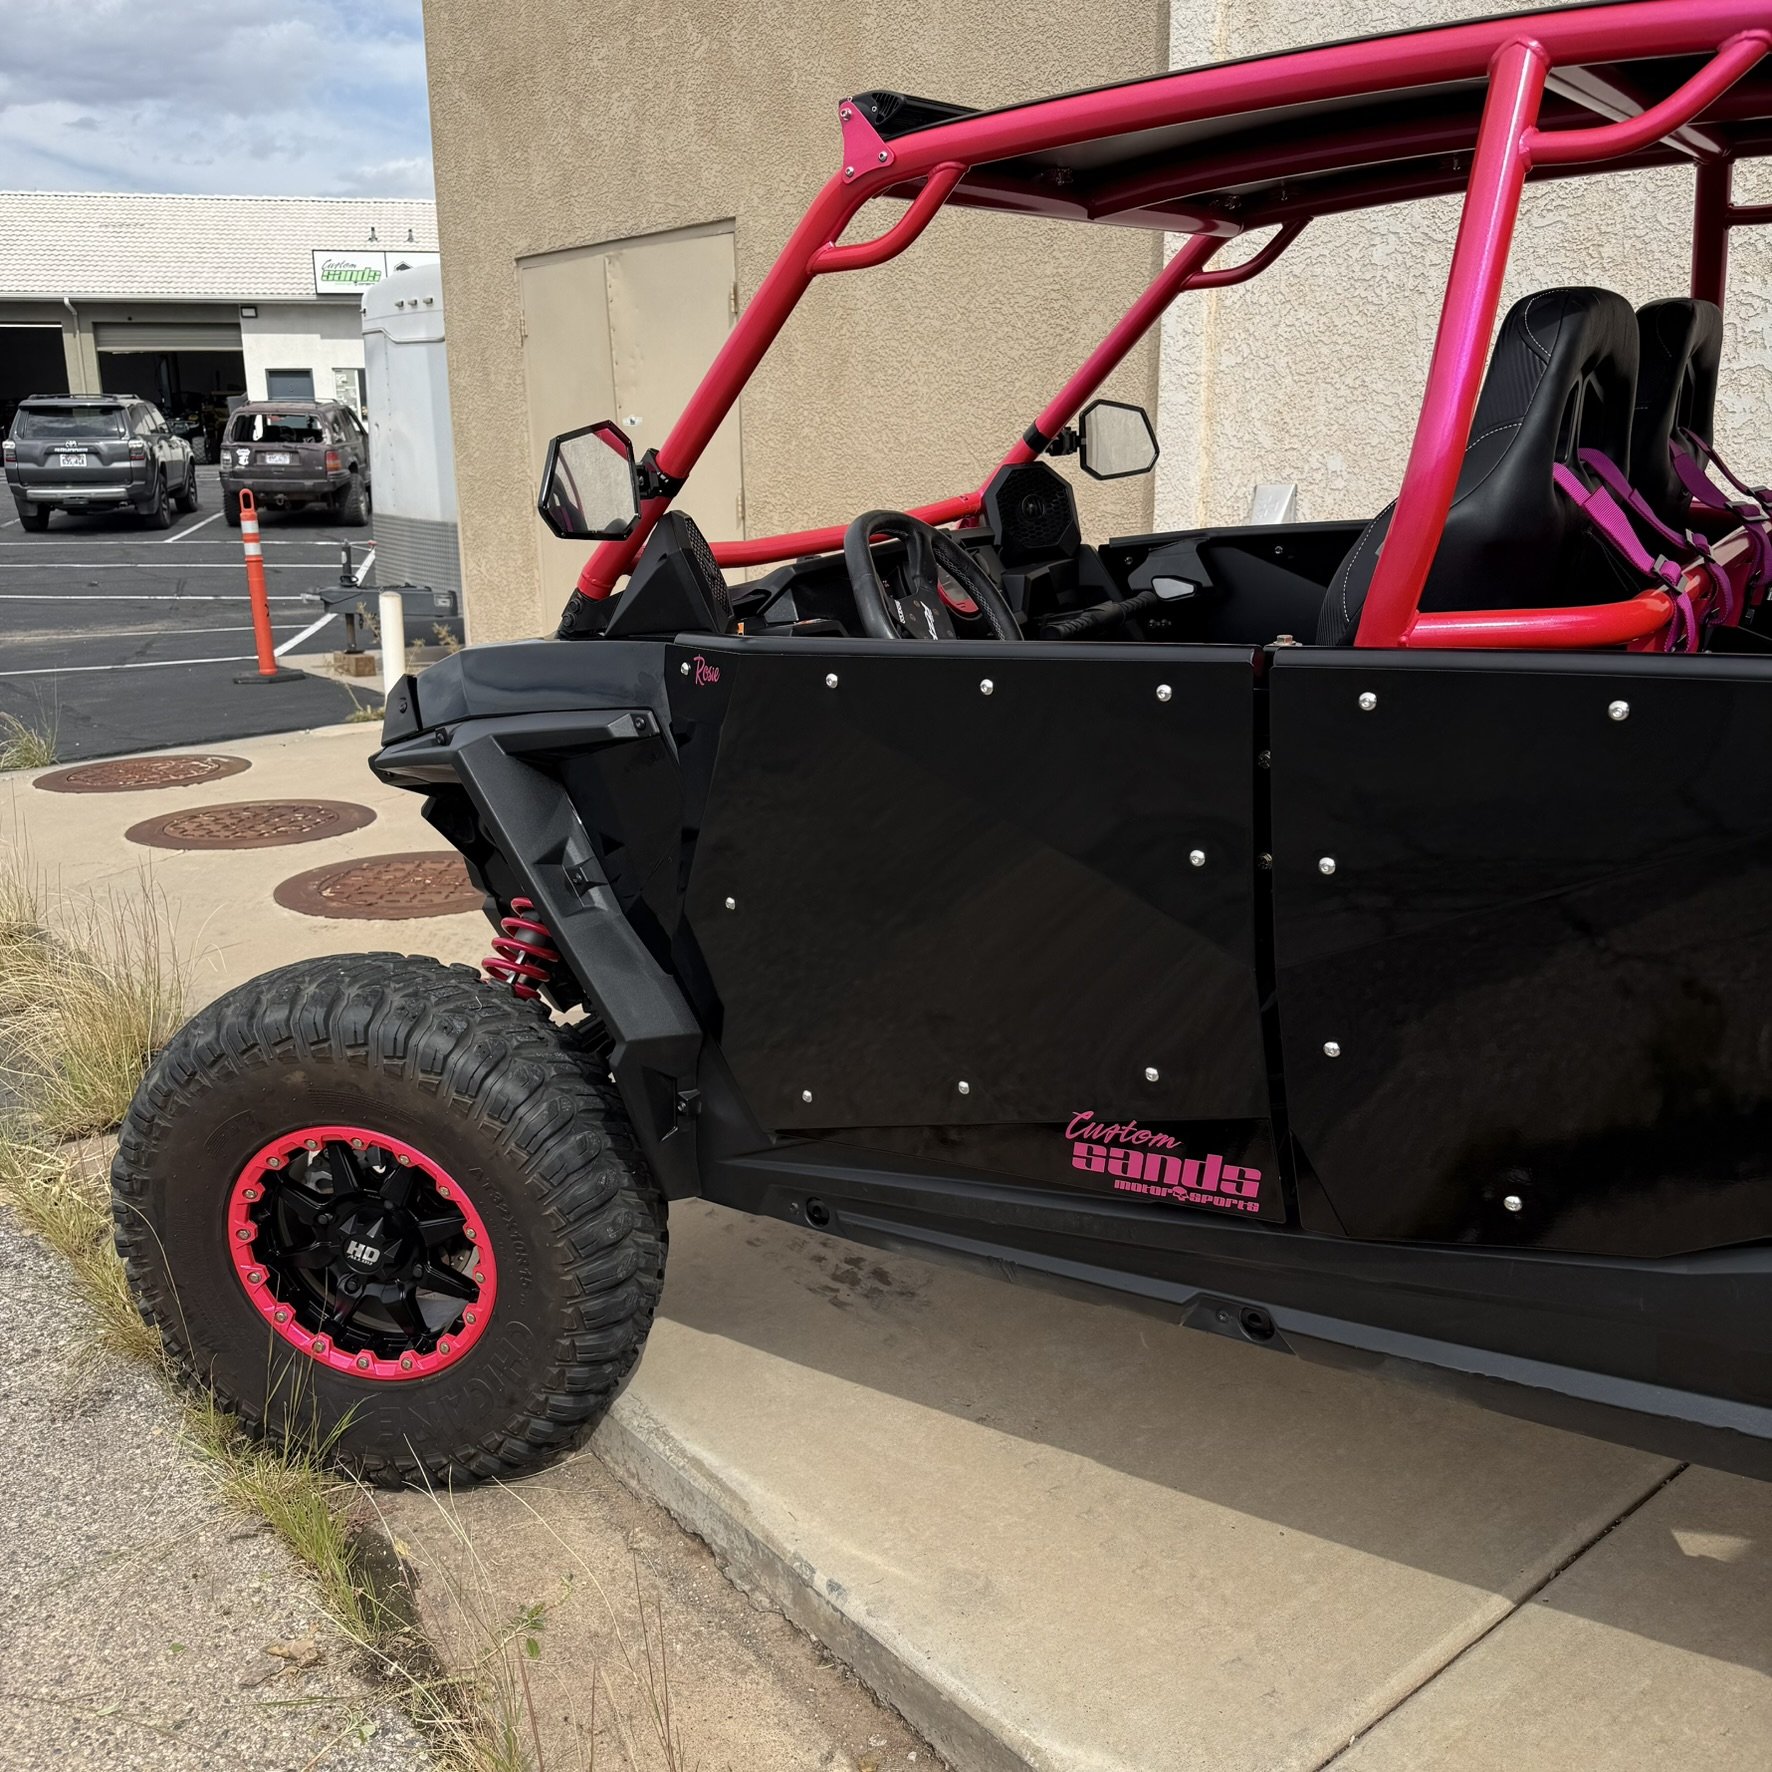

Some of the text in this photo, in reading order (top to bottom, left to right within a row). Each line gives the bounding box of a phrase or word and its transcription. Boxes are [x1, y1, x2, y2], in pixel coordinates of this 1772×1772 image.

[693, 654, 720, 686] Rosie
[1065, 1110, 1182, 1149] Custom
[1071, 1141, 1262, 1198] sands
[346, 1240, 381, 1263] HD
